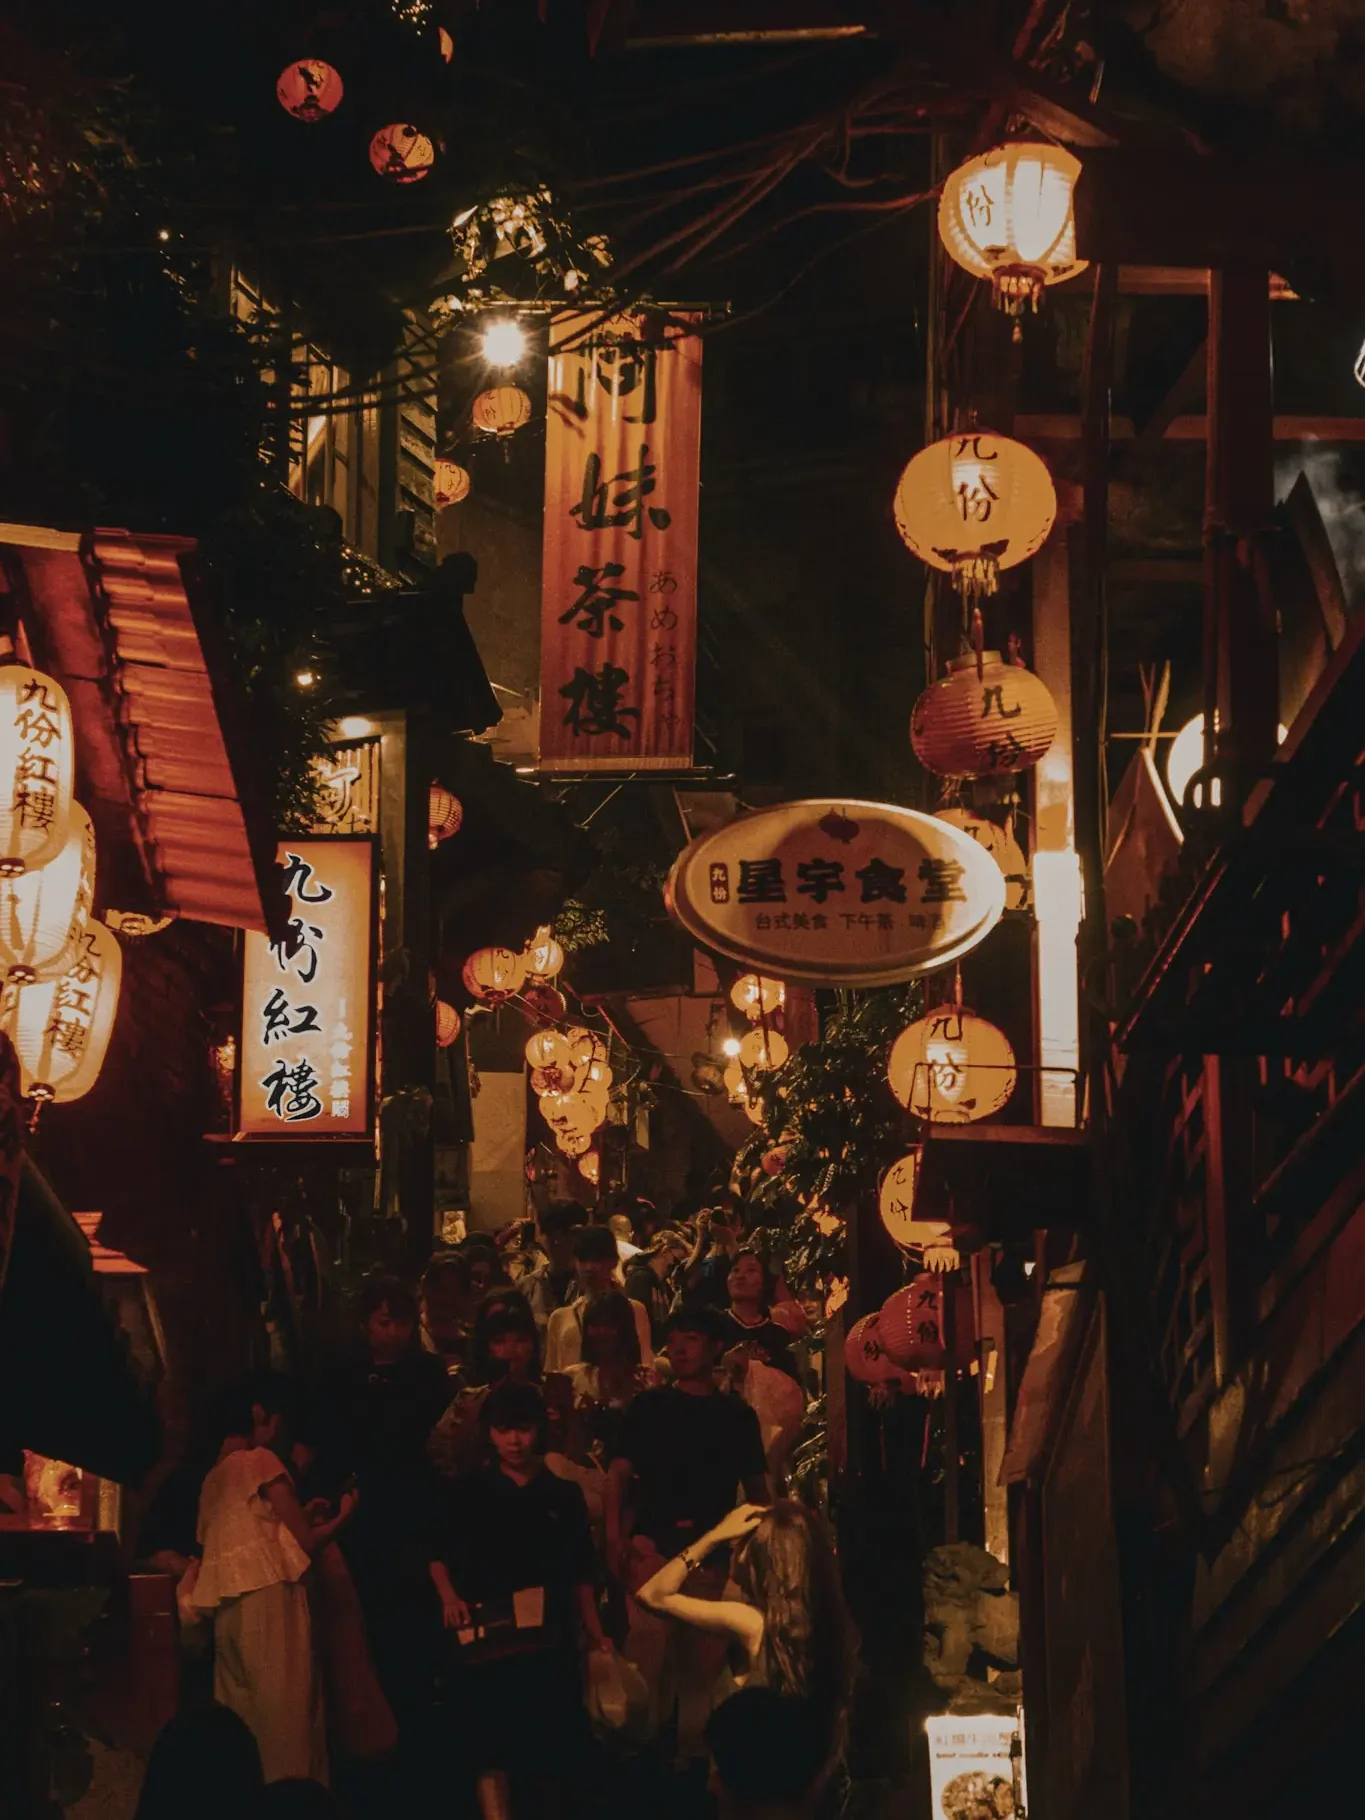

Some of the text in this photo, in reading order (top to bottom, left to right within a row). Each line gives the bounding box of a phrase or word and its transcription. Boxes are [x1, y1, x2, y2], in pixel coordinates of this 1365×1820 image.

[955, 436, 1000, 522] 九份
[981, 685, 1025, 768] 九份
[712, 857, 968, 904] 九份 星宇食堂
[756, 913, 828, 930] 台式美食
[840, 913, 895, 930] 下午茶
[930, 1017, 963, 1092] 九份
[916, 1290, 938, 1344] 九份
